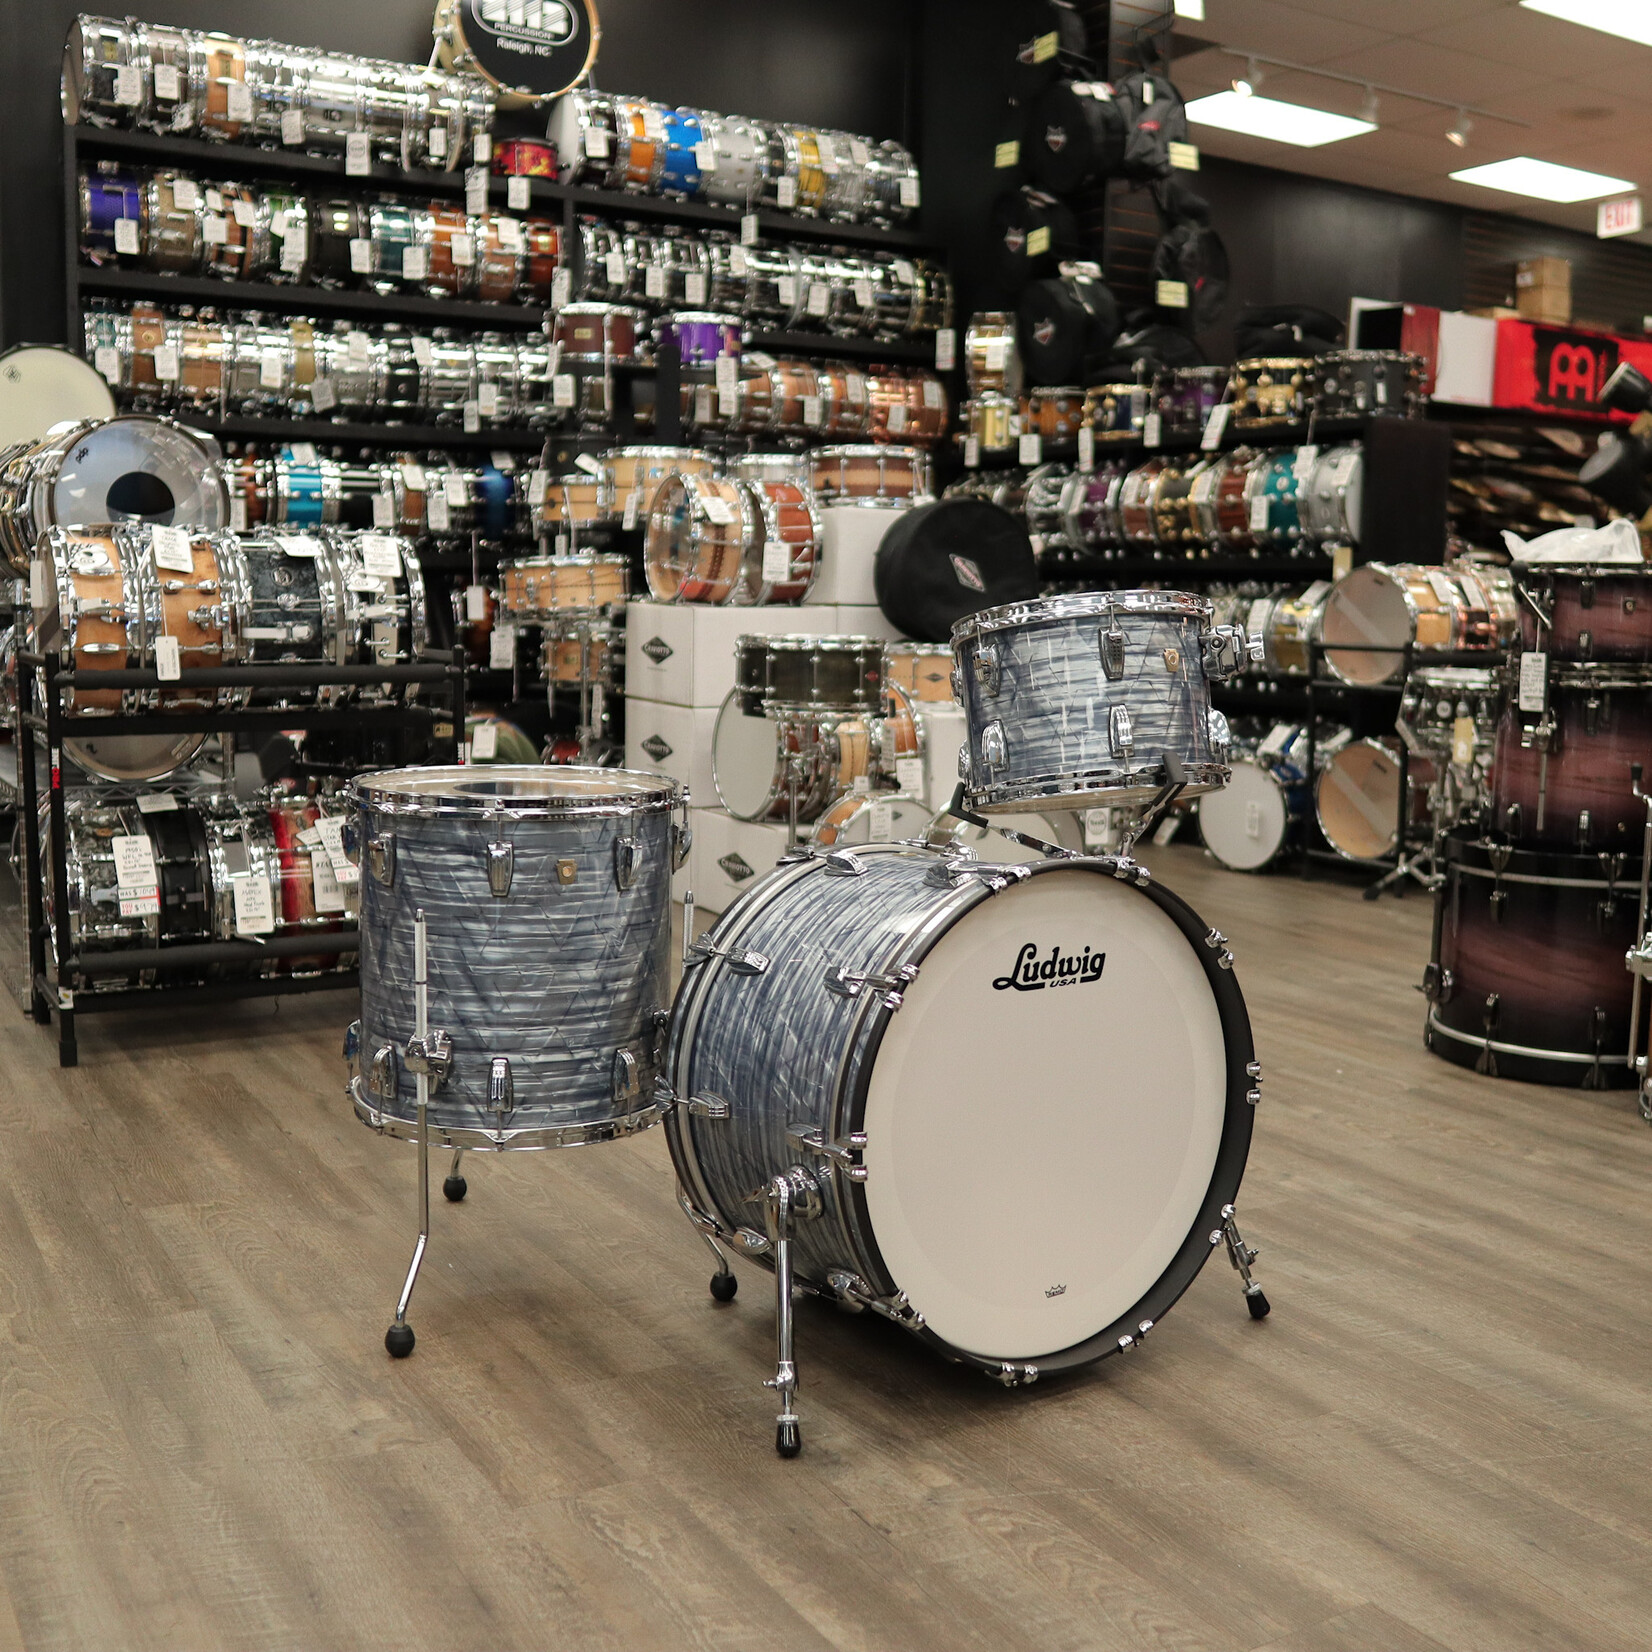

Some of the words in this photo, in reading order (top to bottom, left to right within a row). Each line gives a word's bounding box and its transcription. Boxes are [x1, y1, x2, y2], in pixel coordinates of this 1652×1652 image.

[494, 22, 554, 40] PERCUSSION
[497, 37, 533, 54] Raleigh,
[535, 46, 552, 57] NC
[1605, 200, 1633, 230] EXIT
[120, 888, 132, 898] WAS
[992, 943, 1106, 991] Ludwig
[1050, 978, 1077, 988] USA
